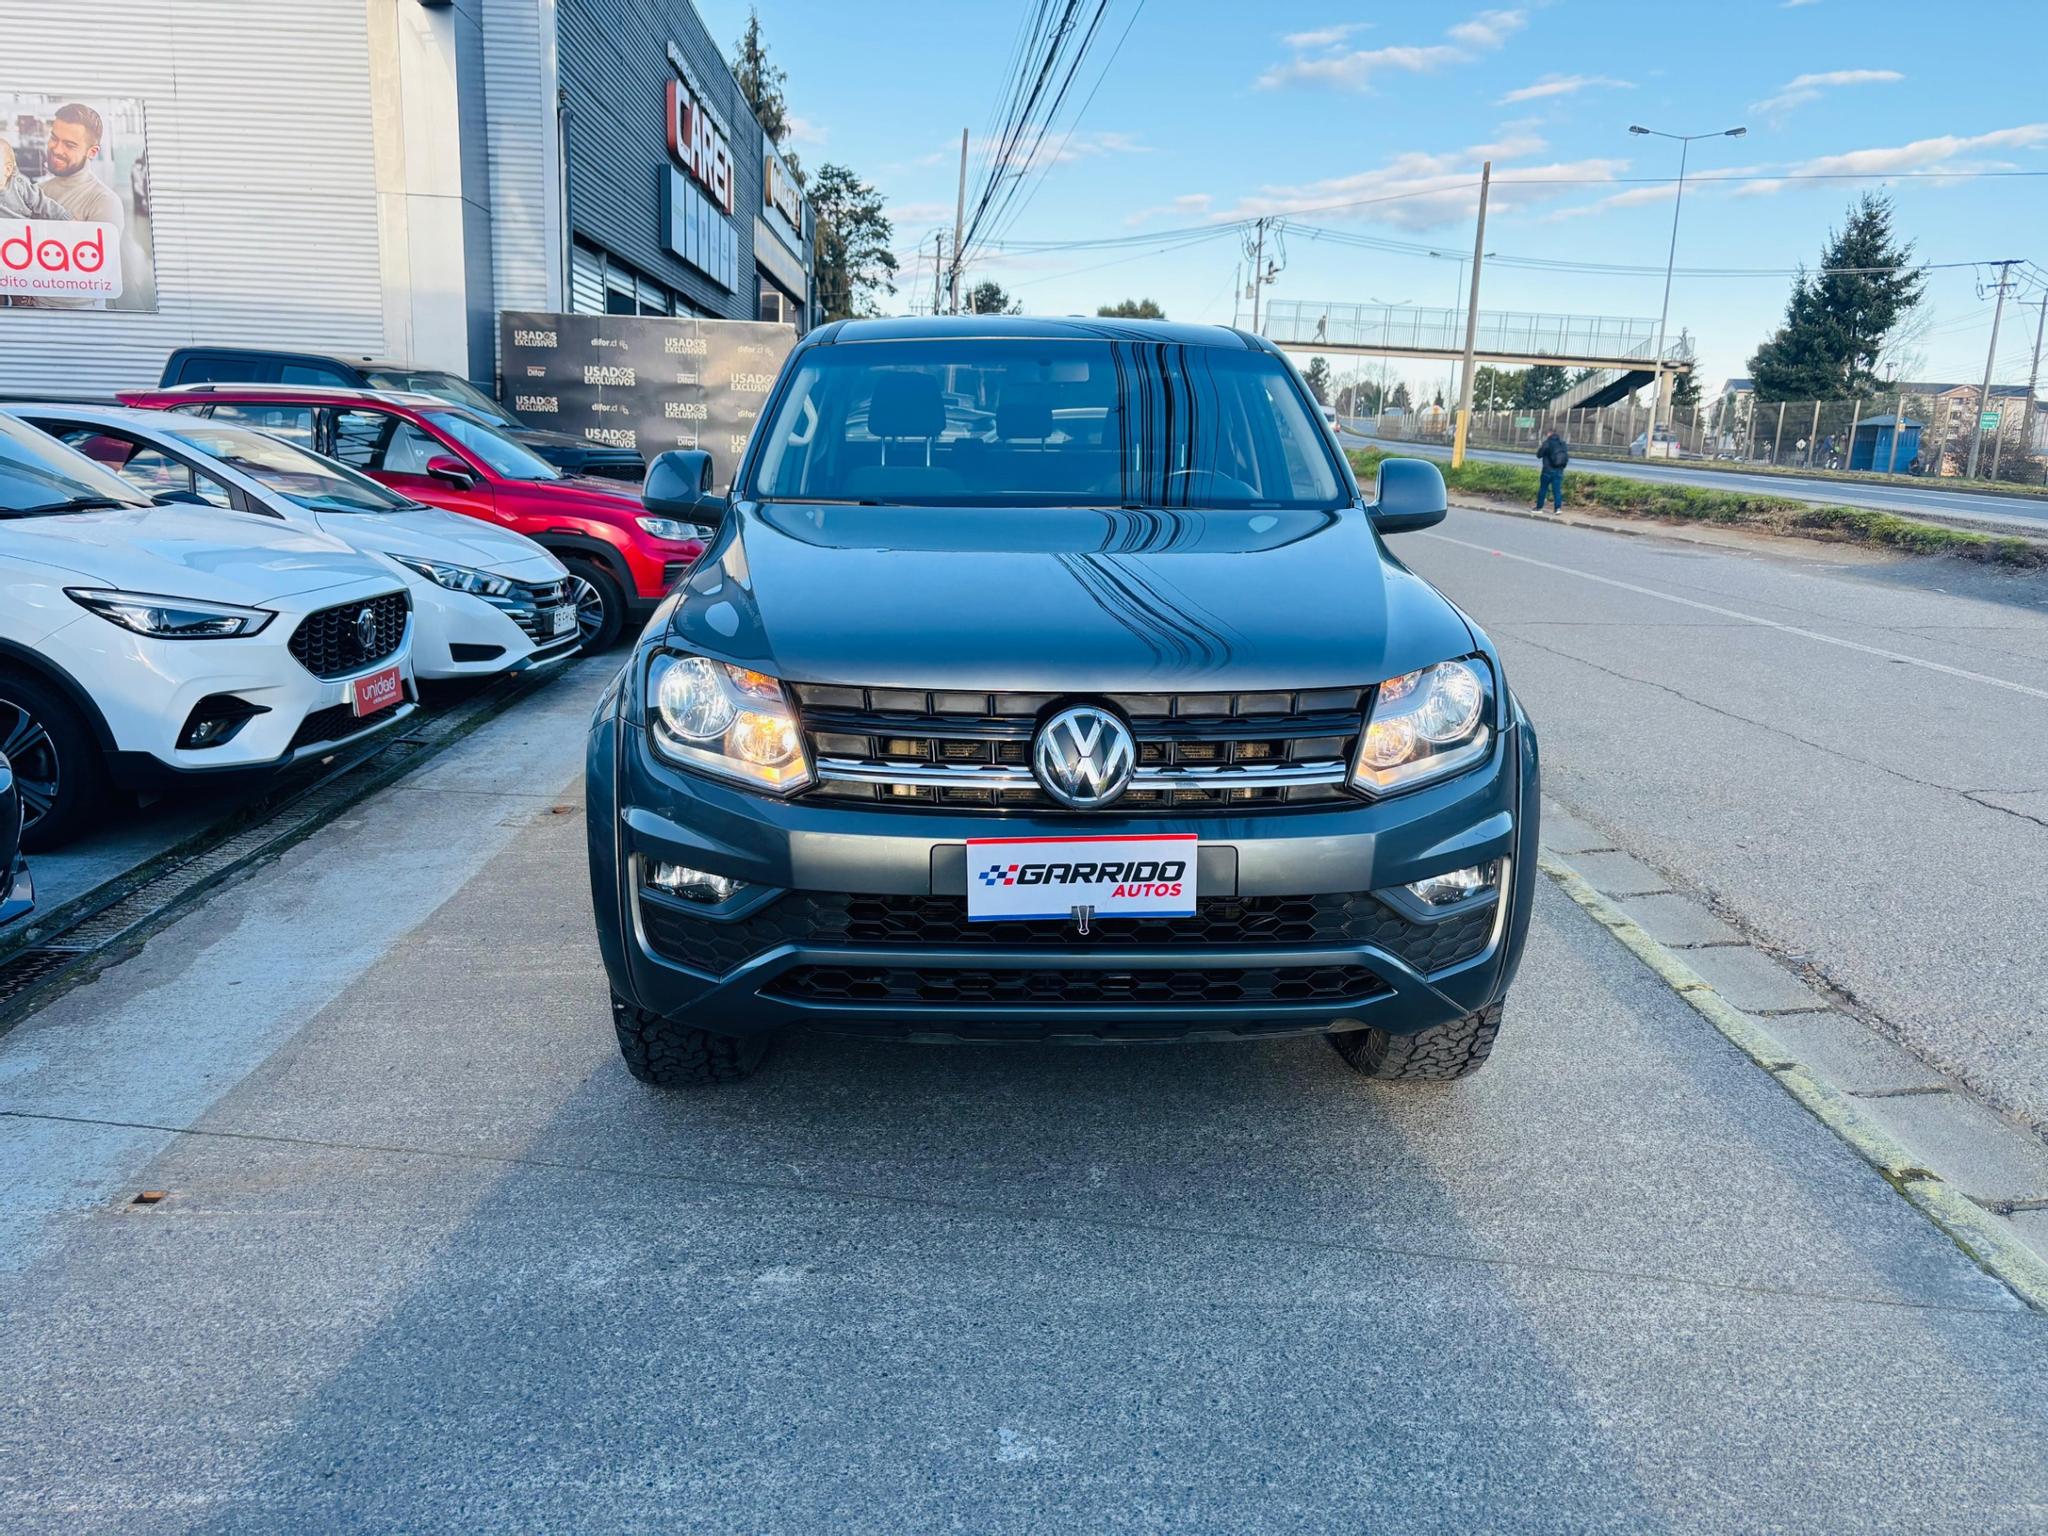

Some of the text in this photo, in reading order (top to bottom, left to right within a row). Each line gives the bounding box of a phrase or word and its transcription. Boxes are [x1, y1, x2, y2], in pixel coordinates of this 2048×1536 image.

[32, 278, 113, 291] automotriz
[514, 330, 557, 341] USADOS
[515, 339, 558, 348] EXCLUSIVOS
[664, 337, 707, 348] USADOS
[664, 346, 708, 355] EXCLUSIVOS
[584, 365, 636, 378] USADOS
[584, 377, 636, 387] EXCLUSIVOS
[730, 373, 777, 384] USADO
[730, 383, 770, 393] EXCLUSIV
[515, 396, 558, 407] USADOS
[516, 404, 559, 413] EXCLUSIVOS
[664, 402, 707, 413] USADOS
[737, 408, 758, 418] difor.
[665, 411, 708, 420] EXCLUSIVOS
[585, 428, 636, 441] USADOS
[362, 671, 396, 701] unidad
[1016, 860, 1186, 886] GARRIDO
[1111, 882, 1183, 898] AUTOS
